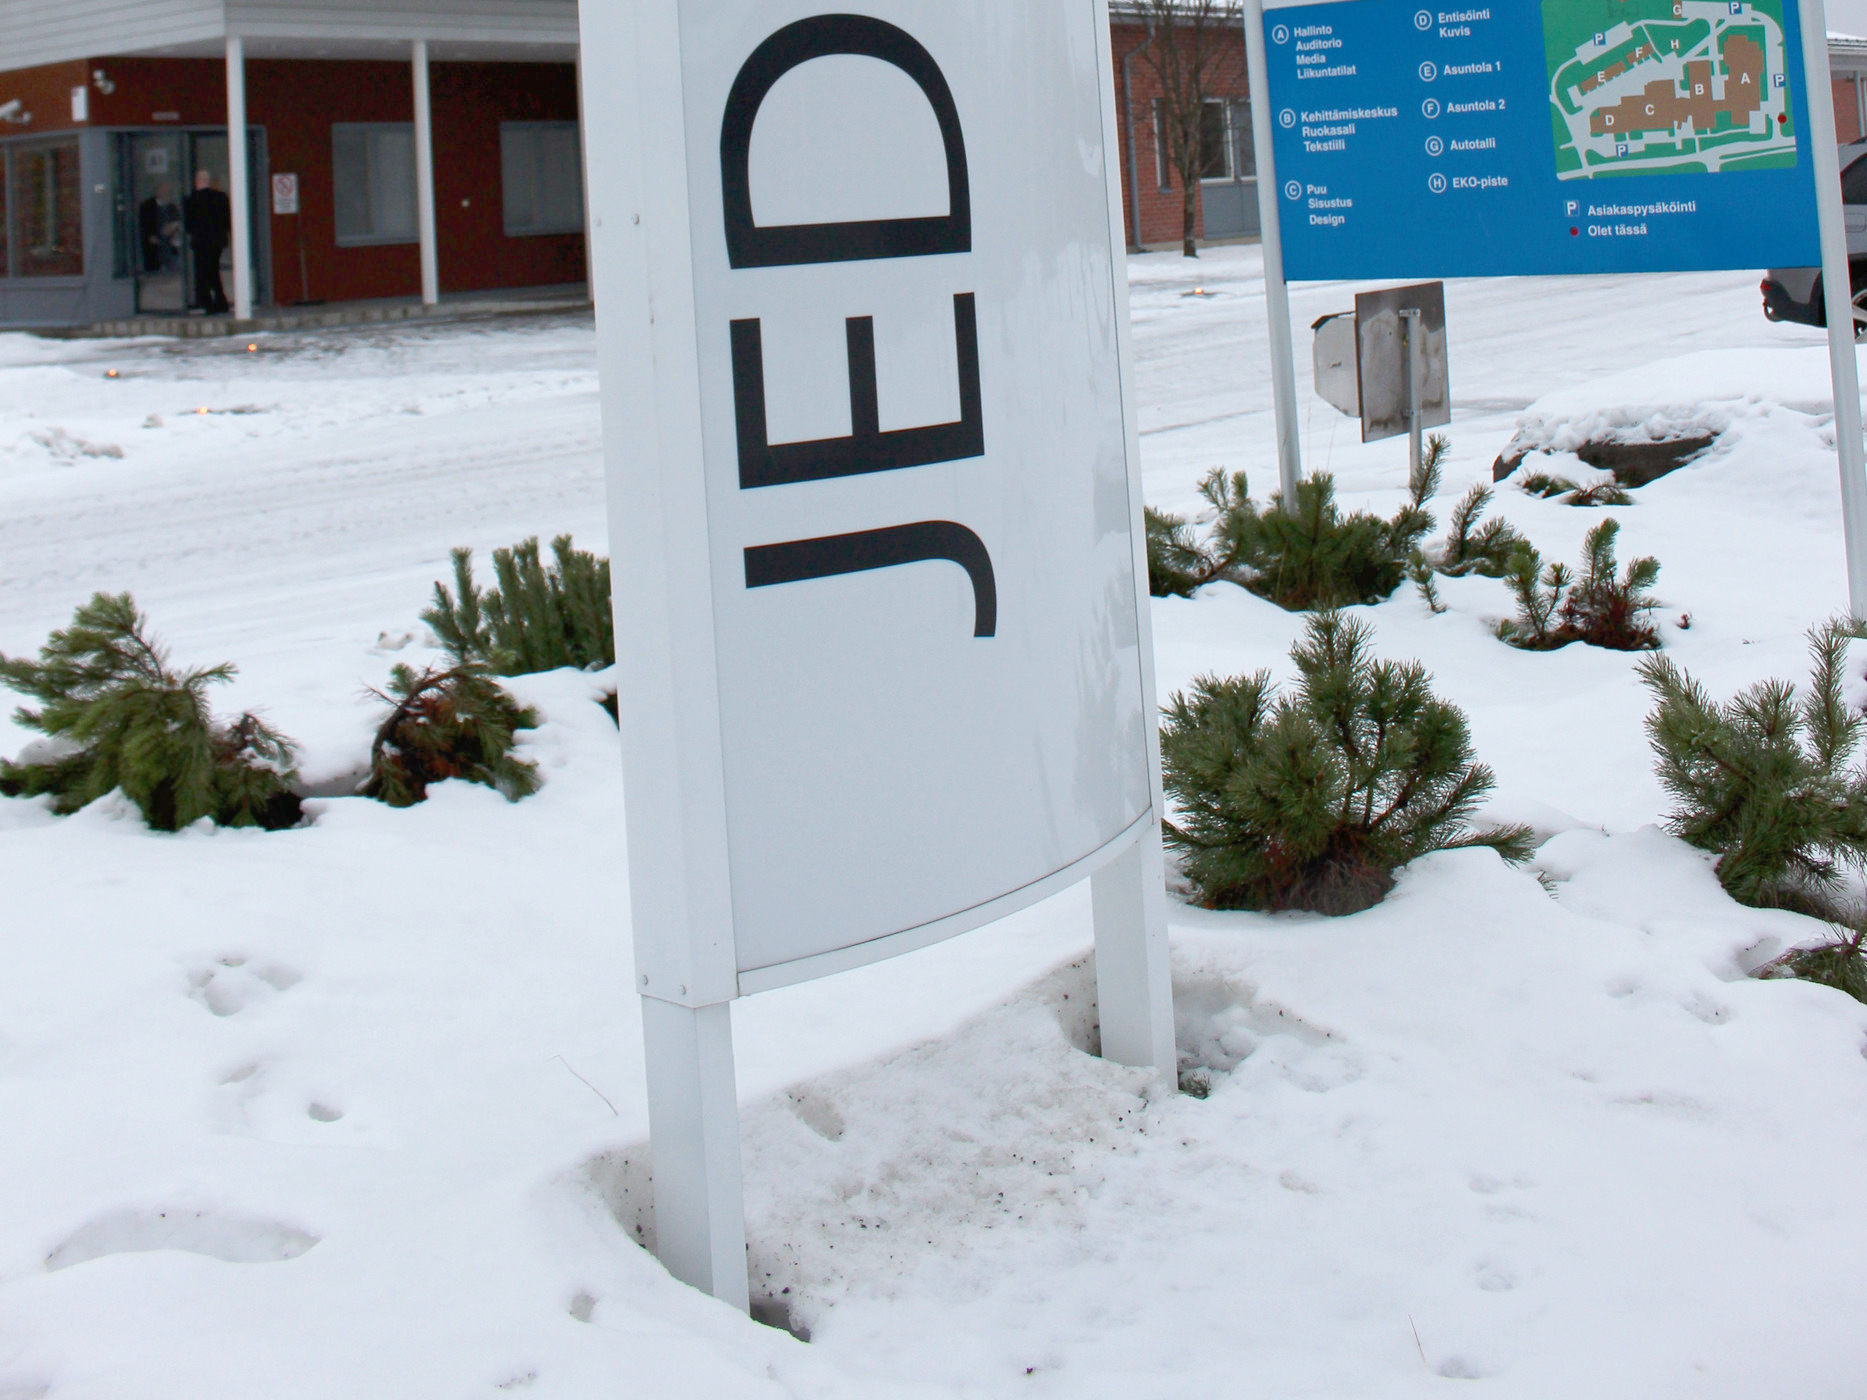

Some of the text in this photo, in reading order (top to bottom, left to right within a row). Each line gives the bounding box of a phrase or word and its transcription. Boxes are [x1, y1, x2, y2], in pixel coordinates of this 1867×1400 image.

[1672, 5, 1682, 15] G
[1731, 2, 1740, 13] P
[1438, 8, 1490, 23] Entisöinti
[1294, 25, 1332, 38] Hallinto
[1439, 26, 1471, 38] Kuvis
[1595, 33, 1603, 44] P
[1671, 40, 1679, 49] H
[1296, 39, 1342, 51] Auditorio
[1635, 47, 1642, 58] F
[1297, 54, 1326, 65] Media
[1298, 65, 1356, 79] Liikuntatilat
[1443, 62, 1492, 76] Asuntola
[1496, 61, 1501, 71] 1
[1597, 72, 1605, 82] E
[1741, 73, 1750, 84] A
[1775, 75, 1784, 86] P
[1695, 85, 1704, 95] B
[1447, 99, 1495, 113] Asuntola
[1498, 99, 1505, 109] 2
[1645, 104, 1655, 115] C
[1301, 106, 1398, 122] Kehittämiskeskus
[1605, 115, 1614, 125] D
[1302, 124, 1355, 137] Ruokasali
[1304, 139, 1345, 152] Tekstiili
[1450, 137, 1496, 150] Autotalli
[1618, 146, 1626, 156] P
[1453, 175, 1508, 189] EKO-piste
[1307, 184, 1327, 195] Puu
[1308, 197, 1352, 209] Sisustus
[1566, 200, 1696, 216] P Asiakaspysäköinti
[1309, 214, 1345, 227] Design
[1588, 223, 1647, 236] Olet tässä
